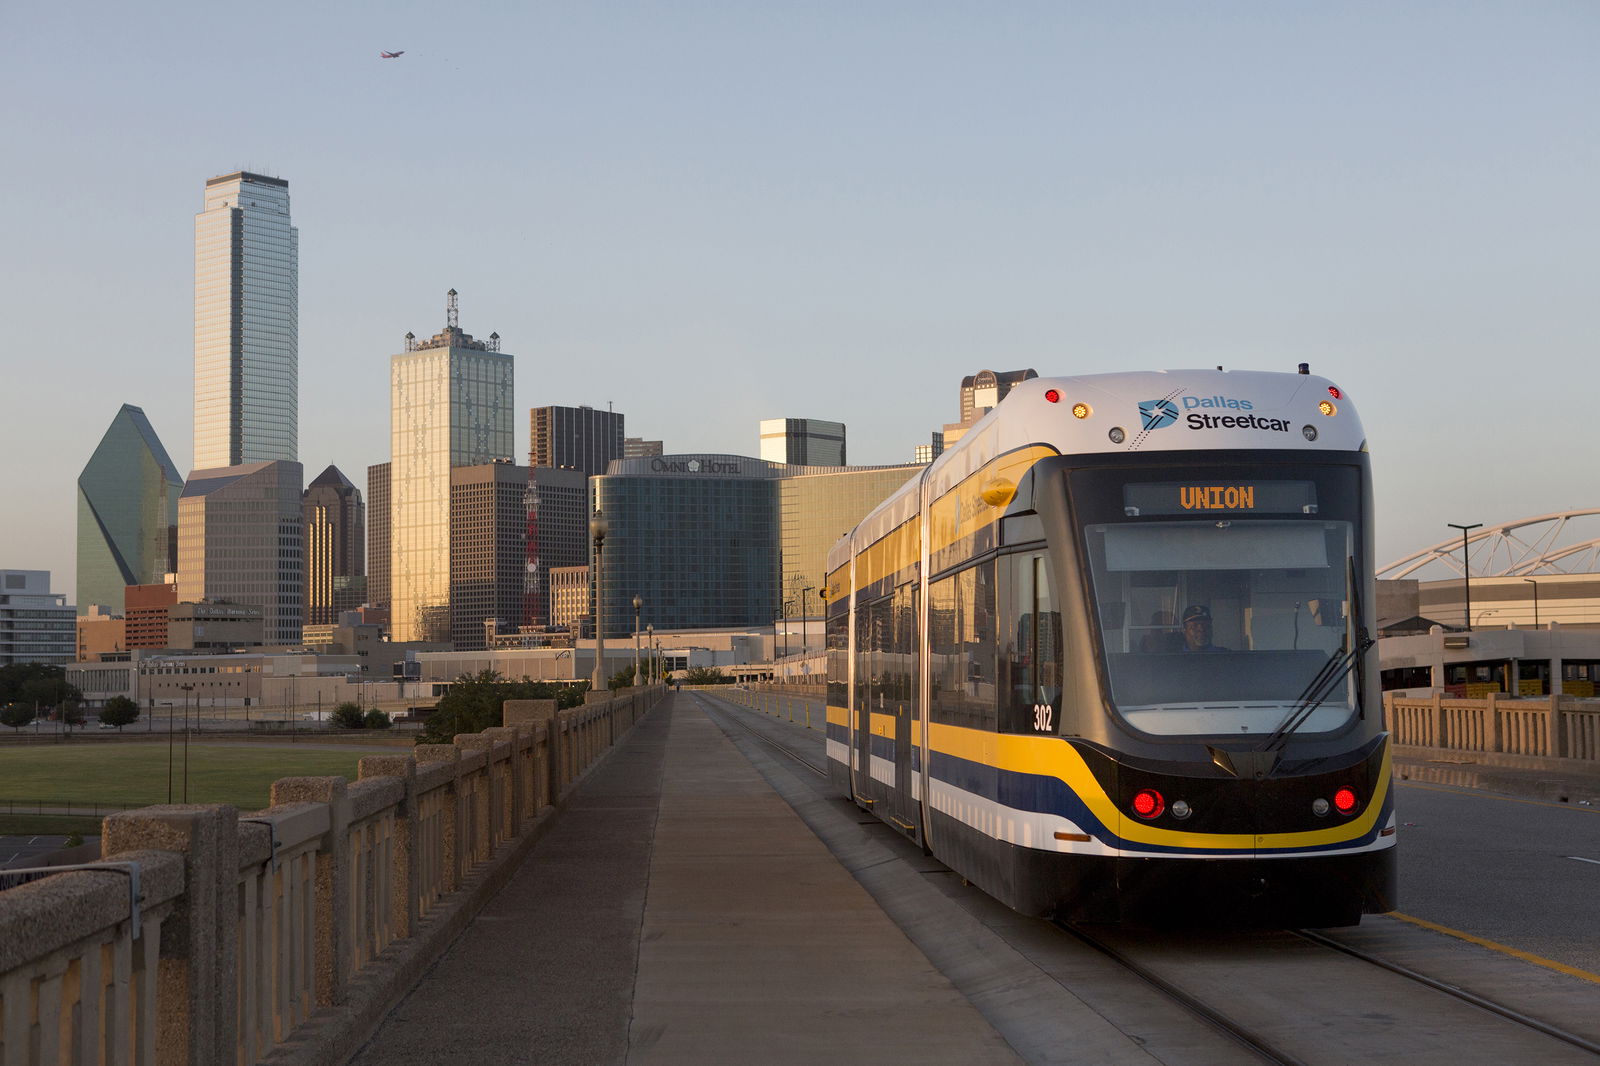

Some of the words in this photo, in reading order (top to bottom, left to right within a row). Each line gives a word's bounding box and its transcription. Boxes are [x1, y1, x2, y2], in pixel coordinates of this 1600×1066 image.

[1182, 395, 1254, 410] Dallas
[1186, 413, 1291, 432] Streetcar
[651, 458, 686, 473] OMNI
[701, 459, 741, 474] HOTEL
[1180, 486, 1254, 510] UNION
[1033, 704, 1052, 731] 302
